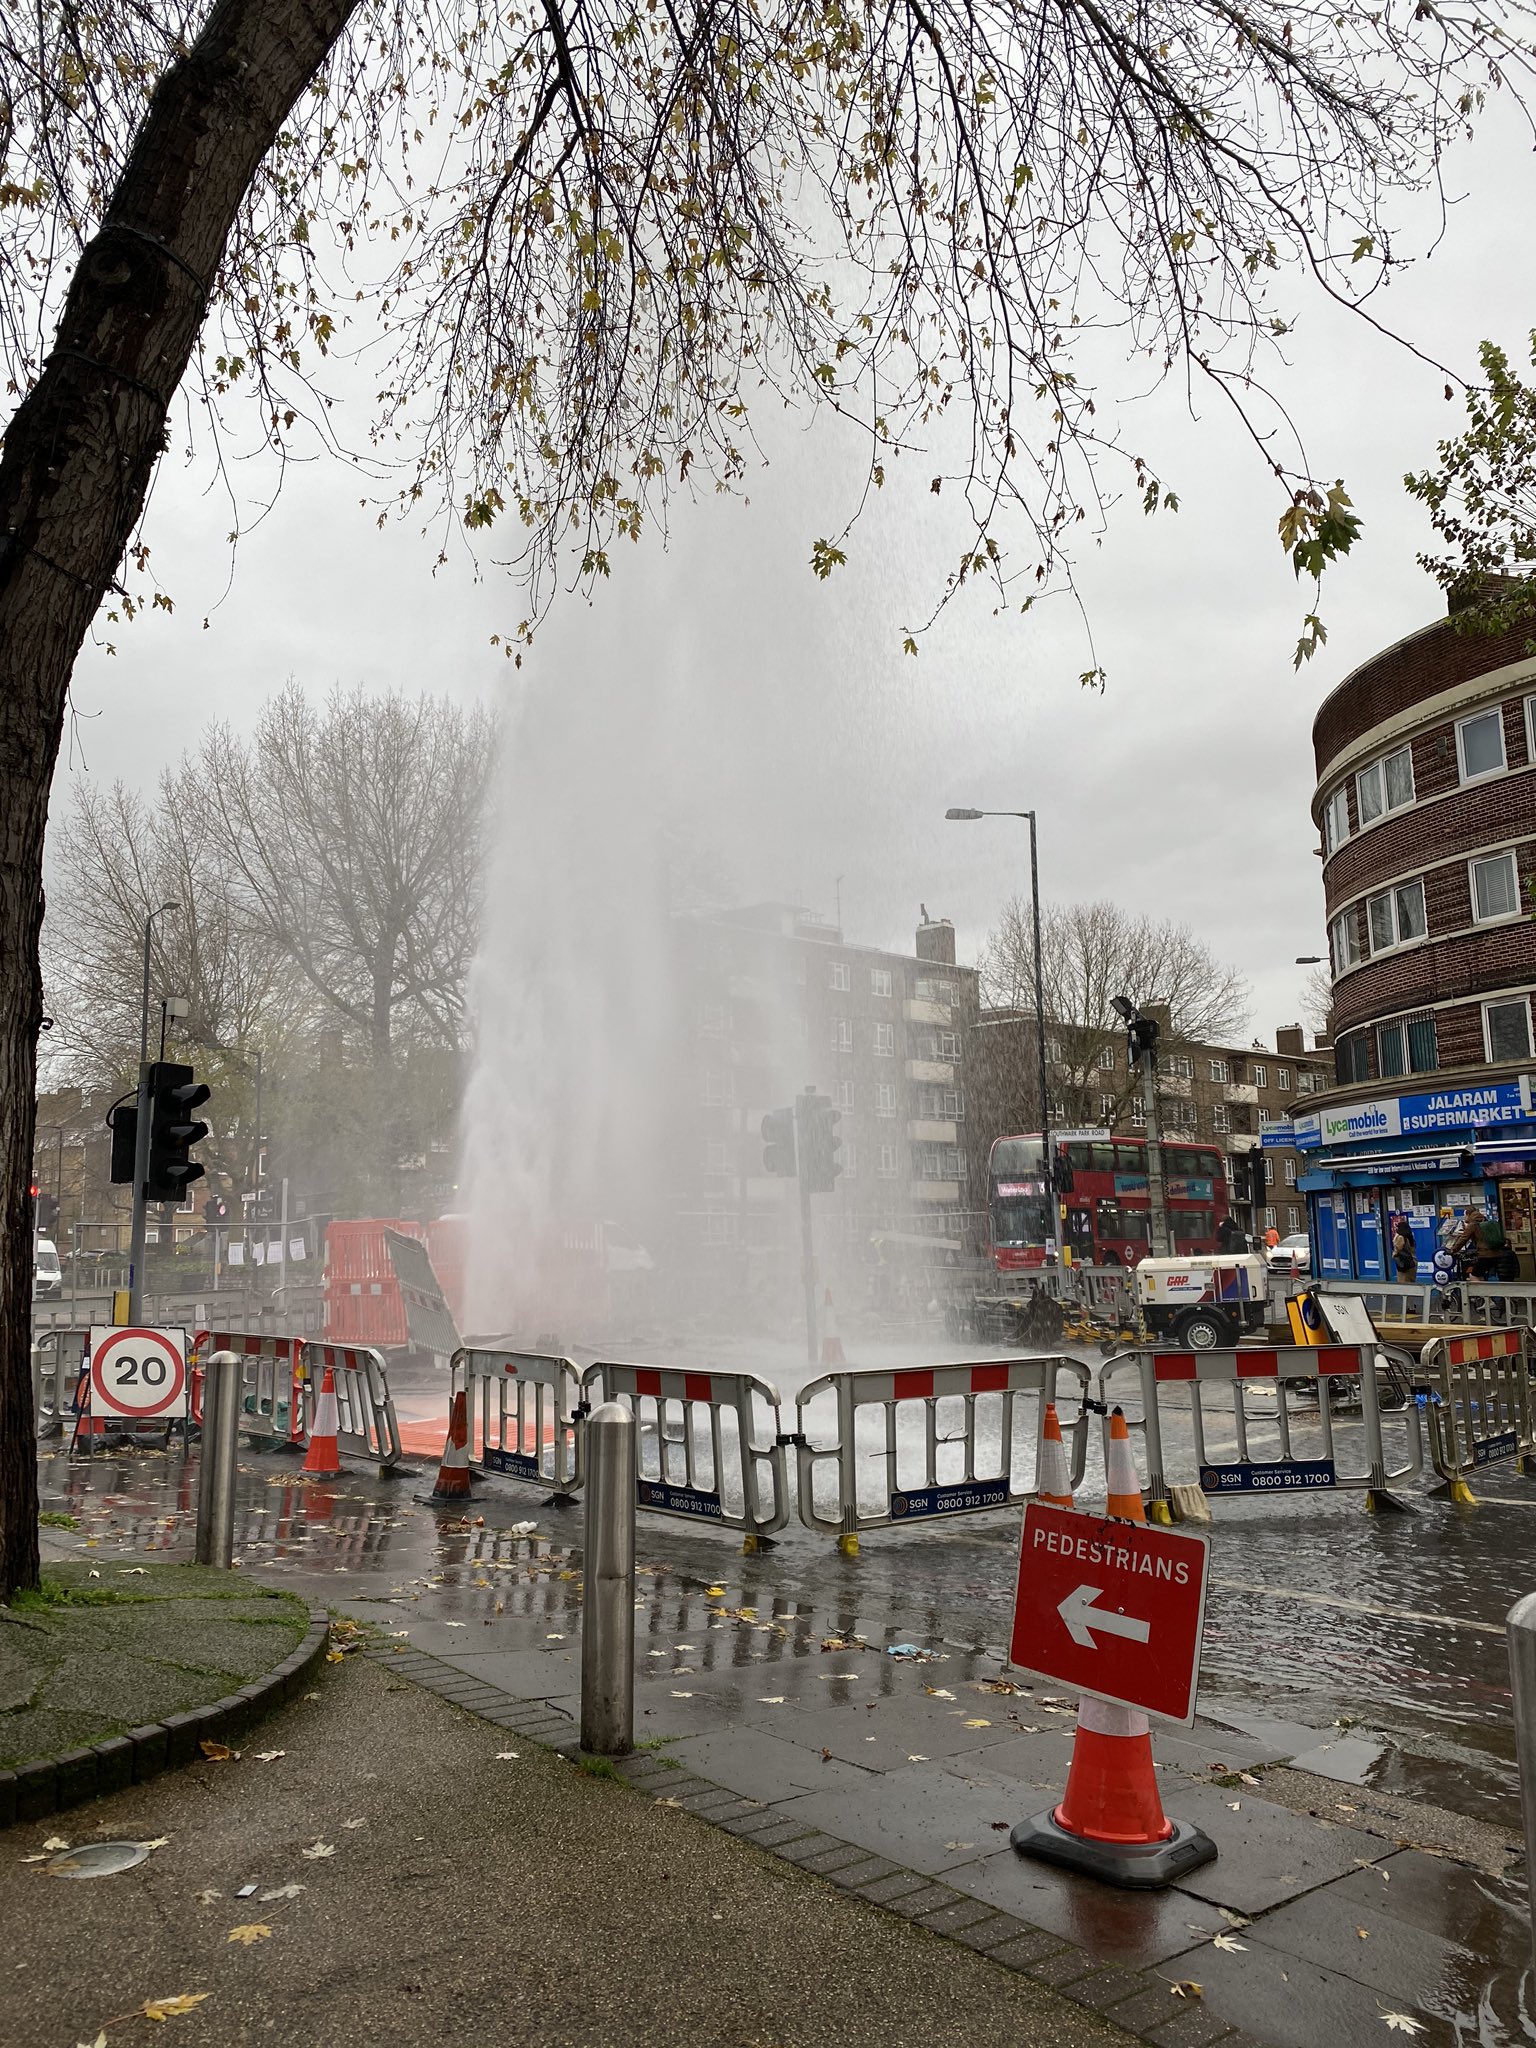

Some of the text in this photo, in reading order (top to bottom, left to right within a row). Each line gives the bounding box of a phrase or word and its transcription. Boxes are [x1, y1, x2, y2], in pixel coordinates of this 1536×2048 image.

[1428, 1090, 1497, 1110] JALARAM
[1326, 1108, 1387, 1136] Lycamobile
[1411, 1105, 1521, 1130] SUPERMARKET
[1167, 1276, 1189, 1286] GAP
[115, 1356, 166, 1386] 20
[505, 1463, 518, 1473] 0800
[528, 1468, 540, 1478] 1700
[1221, 1474, 1242, 1483] SGN
[1252, 1474, 1330, 1486] 0800 912 1700
[651, 1490, 664, 1500] SGN
[909, 1498, 928, 1508] SGN
[937, 1492, 1004, 1510] 0800 912 1700
[670, 1498, 720, 1514] 0800 912 1700
[1034, 1528, 1189, 1584] PEDESTRIANS
